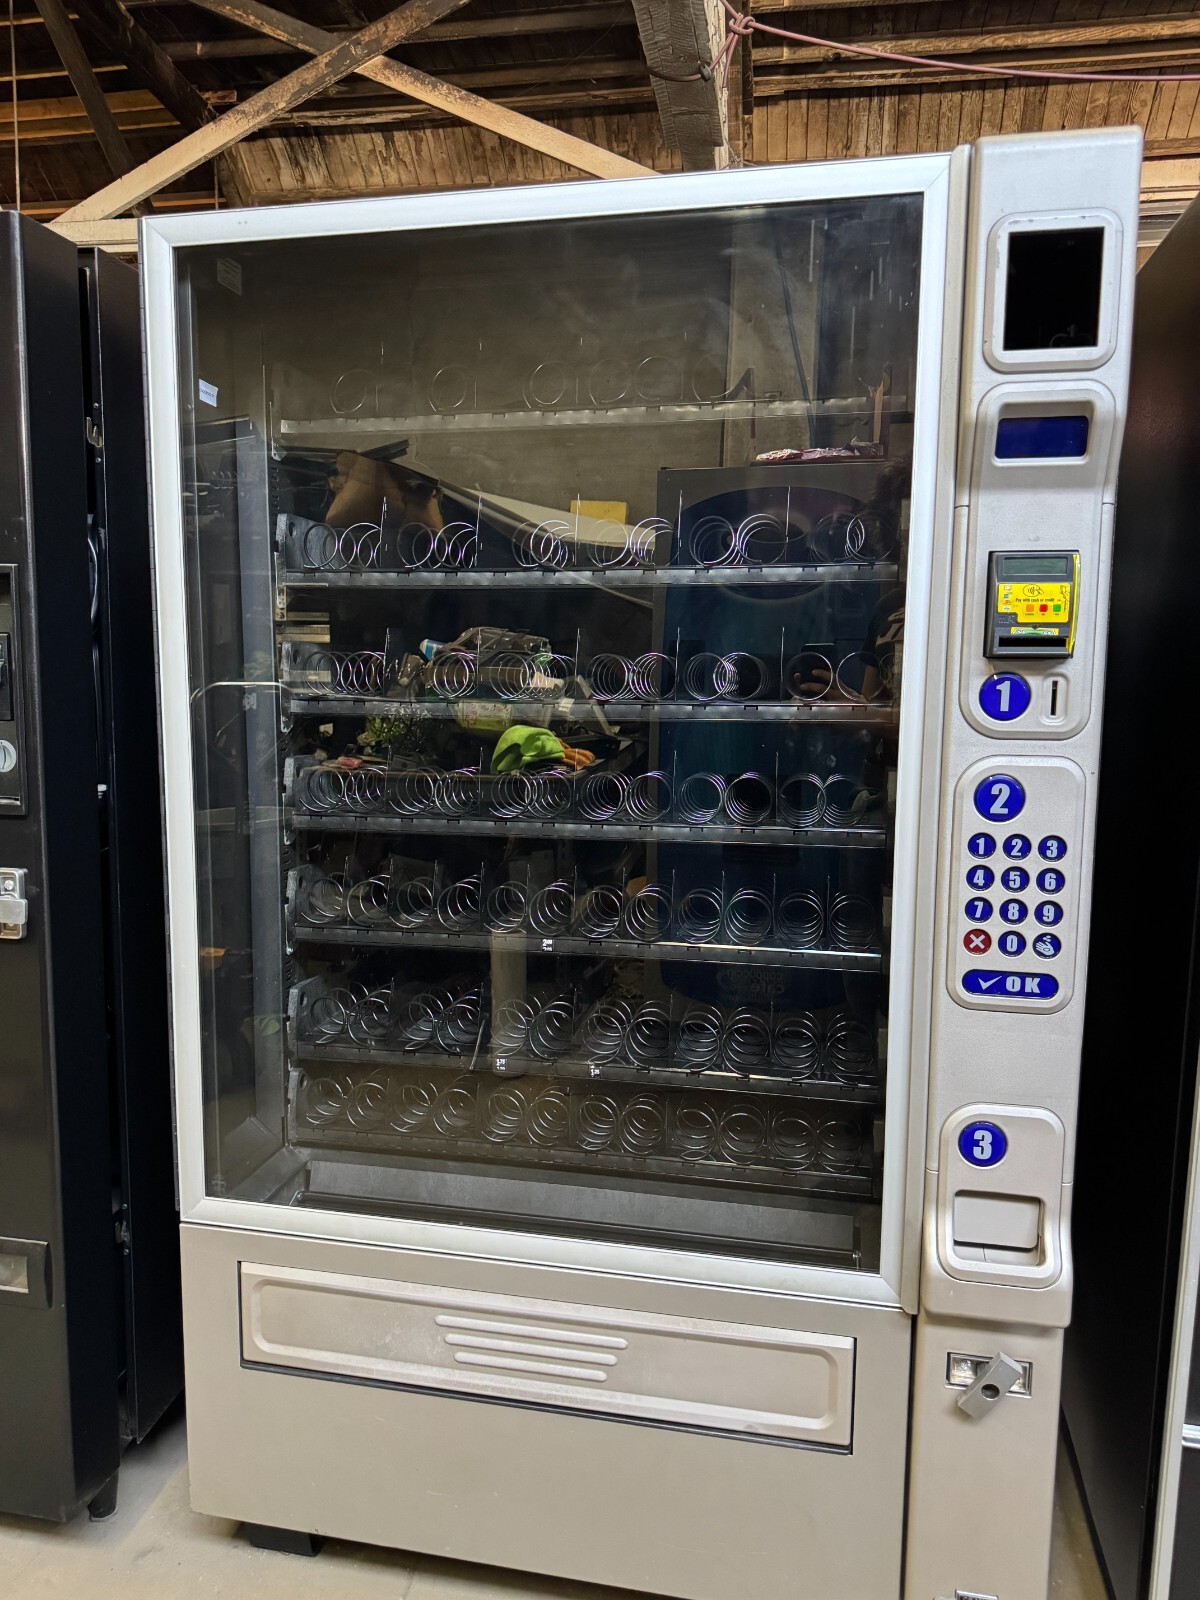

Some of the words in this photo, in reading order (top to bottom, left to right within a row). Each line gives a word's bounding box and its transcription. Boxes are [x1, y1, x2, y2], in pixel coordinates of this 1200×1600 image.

[995, 681, 1011, 712] 1
[989, 782, 1011, 815] 2
[975, 837, 985, 855] 1
[1010, 839, 1023, 856] 2
[1046, 840, 1058, 858] 3
[973, 869, 985, 887] 4
[1008, 870, 1021, 889] 5
[1044, 872, 1056, 891] 6
[974, 901, 984, 918] 7
[1007, 902, 1020, 920] 8
[1042, 904, 1054, 922] 9
[1006, 934, 1018, 952] 0
[1005, 976, 1041, 994] OK
[973, 1129, 993, 1160] 3
